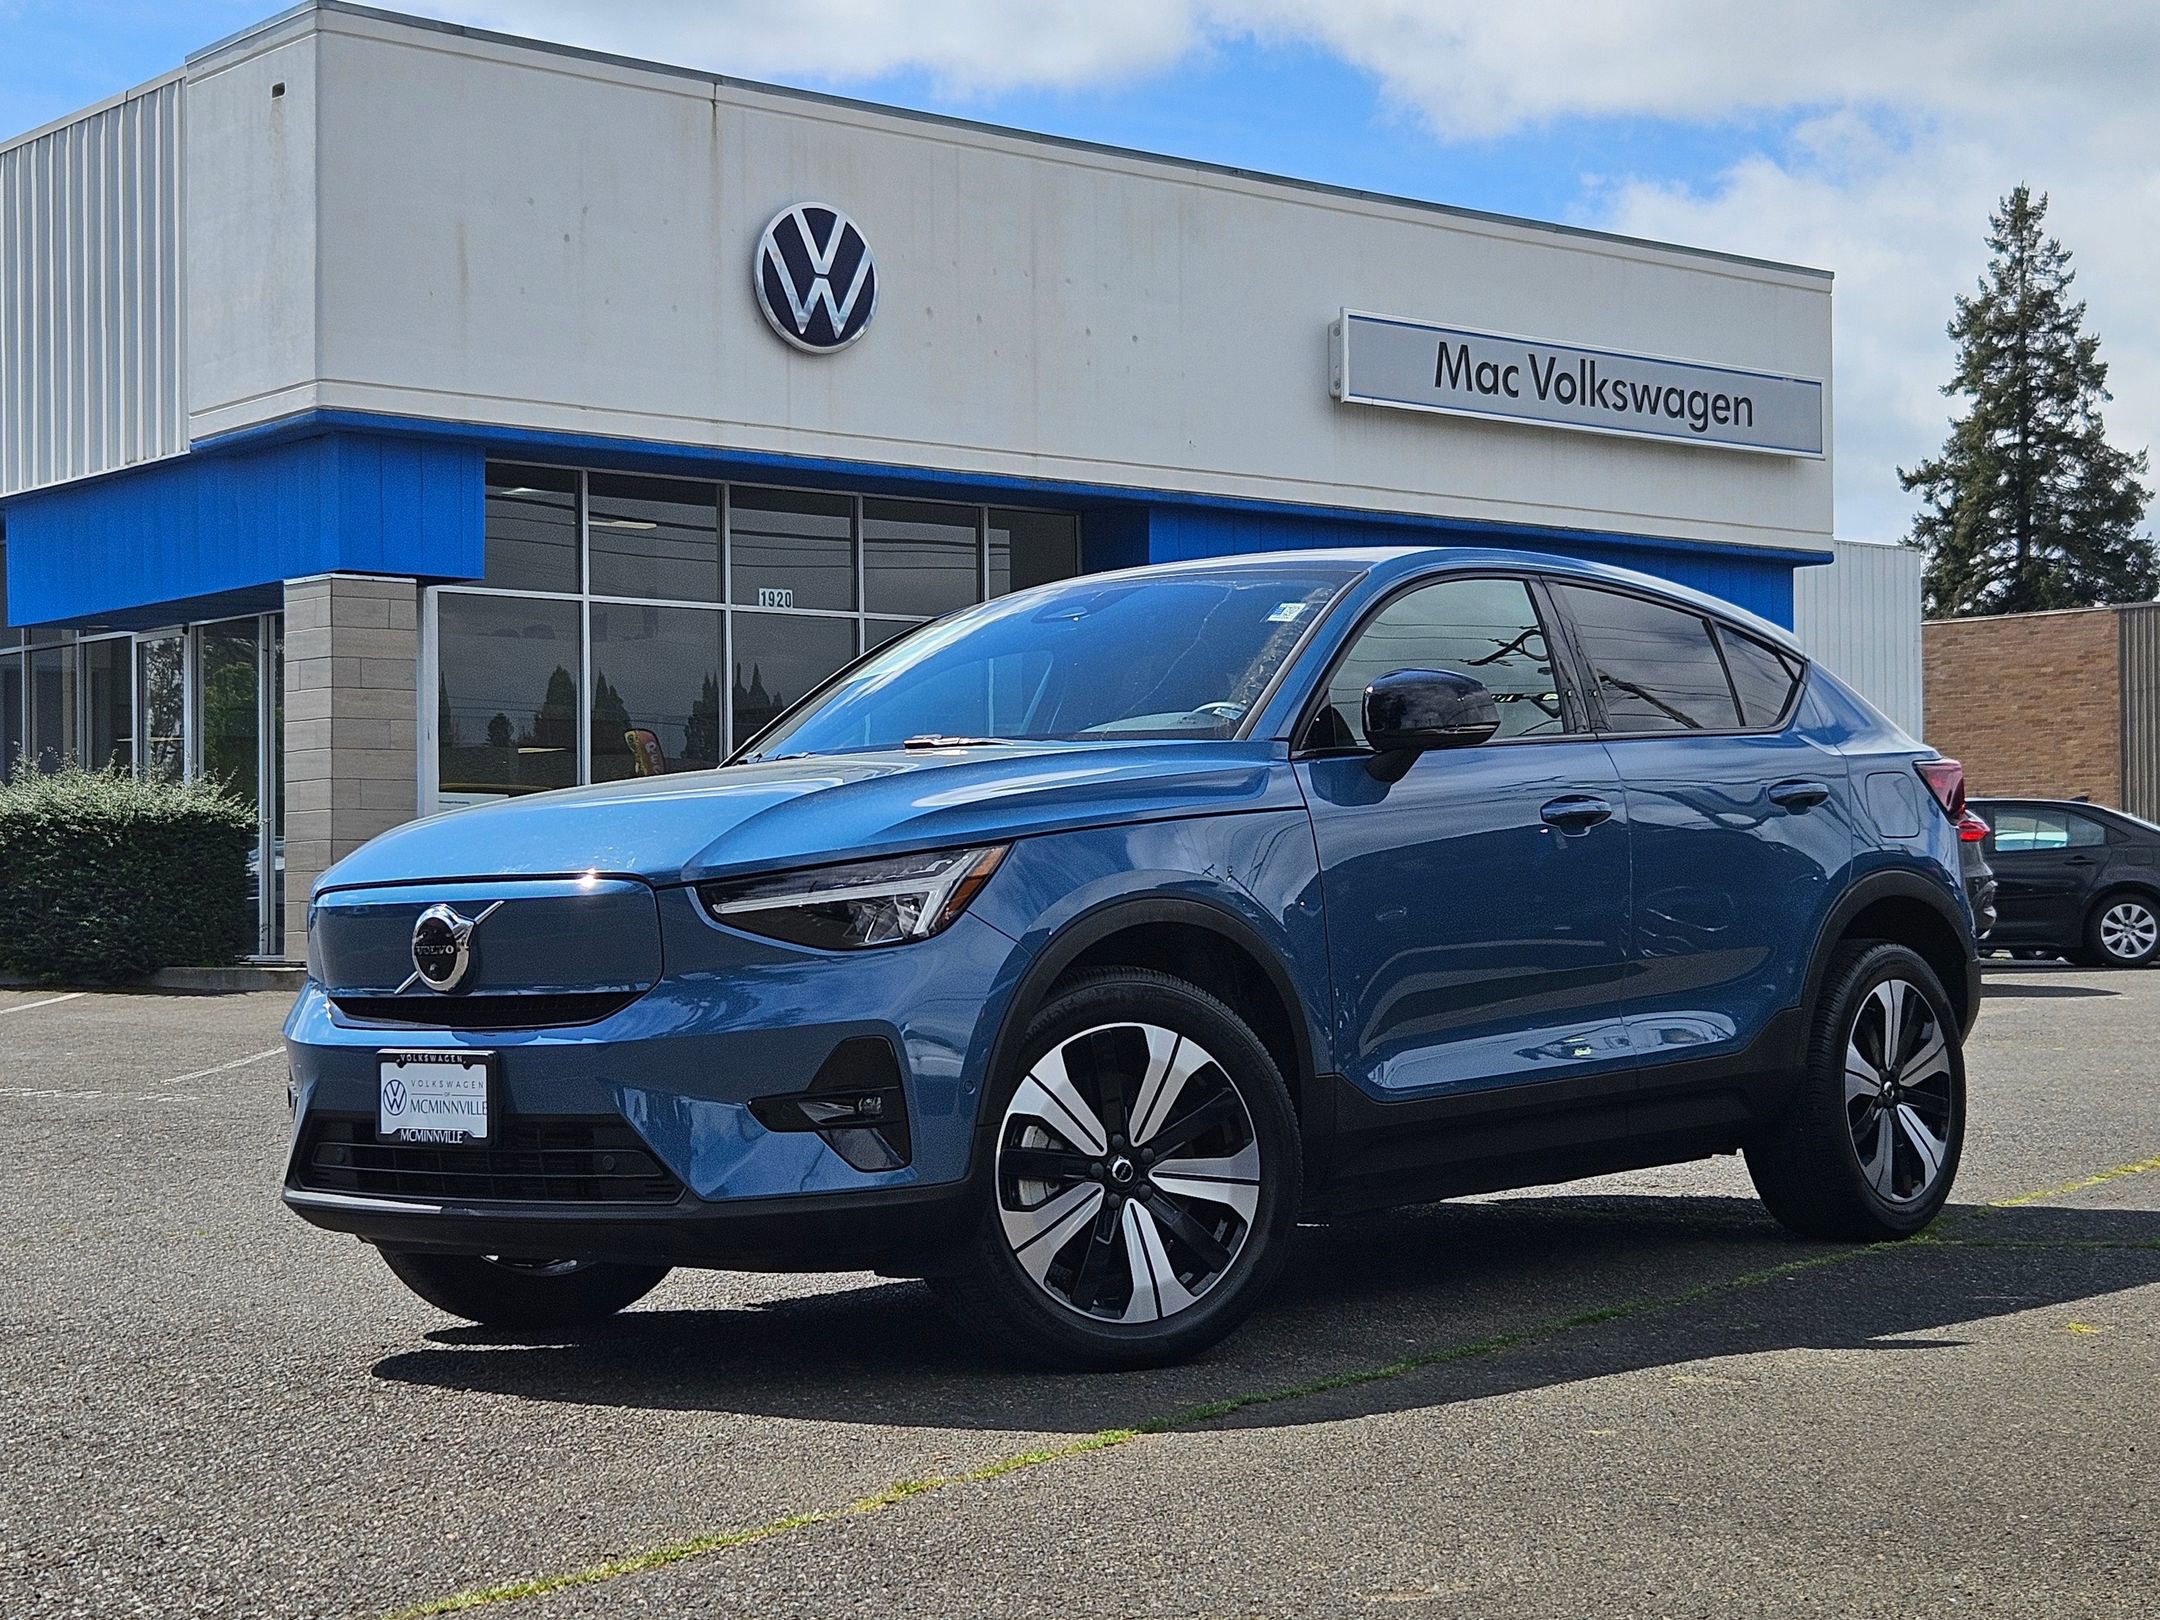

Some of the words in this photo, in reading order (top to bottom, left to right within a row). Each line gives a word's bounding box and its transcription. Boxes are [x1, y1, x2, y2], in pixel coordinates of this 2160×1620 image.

[1433, 340, 1519, 399] Mac
[1528, 353, 1753, 433] Volkswagen
[761, 591, 792, 608] 1920
[415, 944, 455, 955] VOLVO
[400, 1053, 463, 1063] VOLKSWAGEN
[411, 1079, 484, 1089] VOLKSWAGEN
[410, 1098, 488, 1116] MCMINNVILLE
[400, 1128, 464, 1144] MCMINNVILLE
